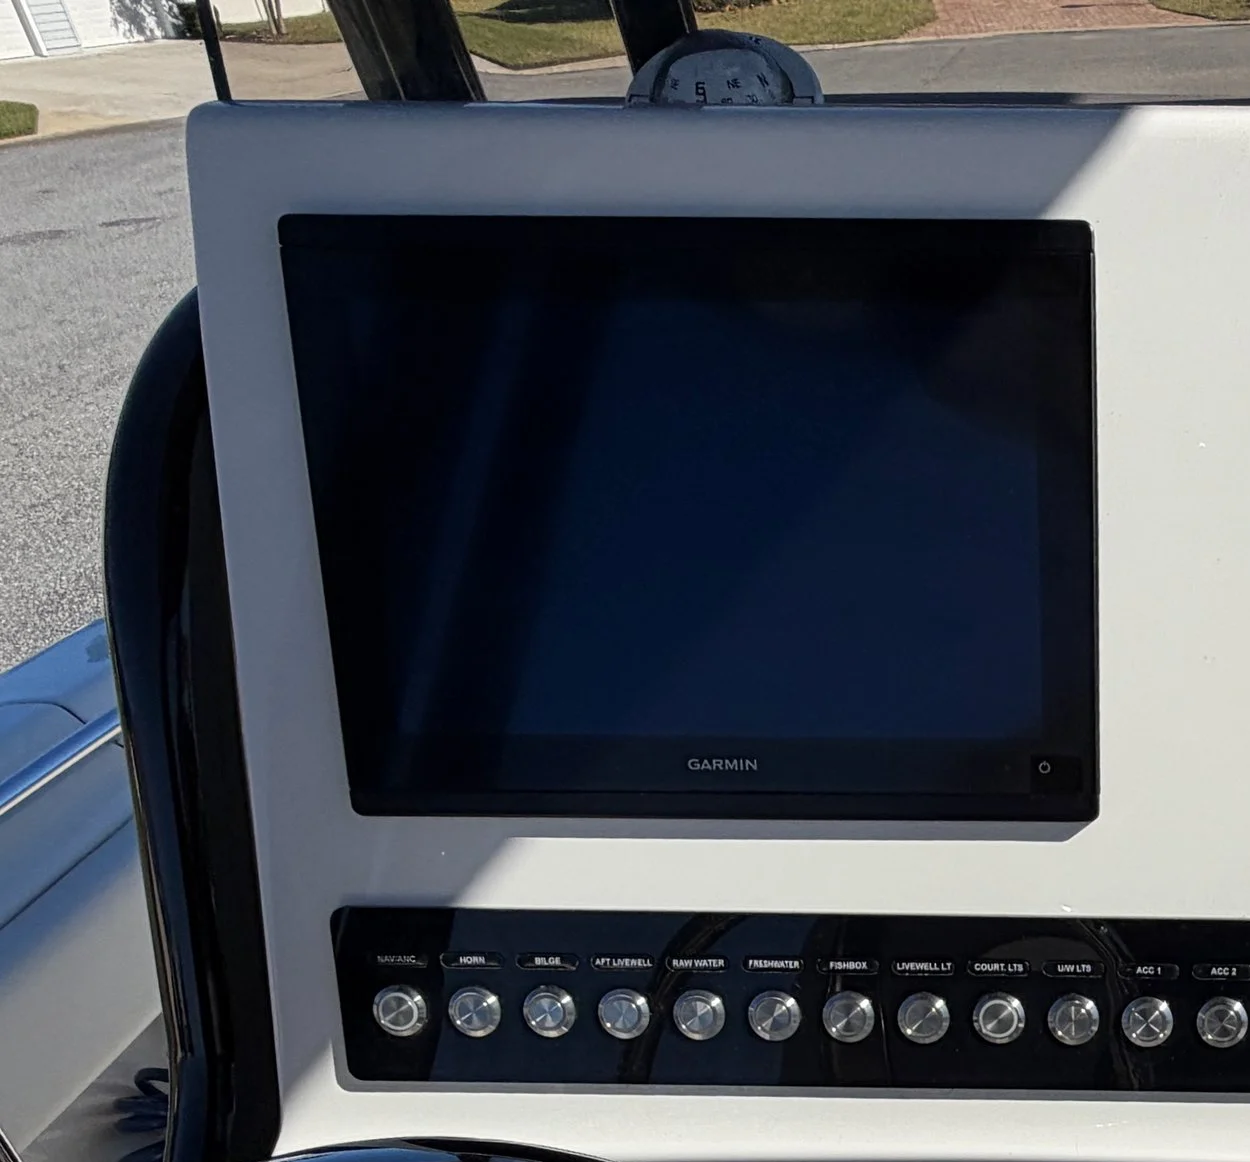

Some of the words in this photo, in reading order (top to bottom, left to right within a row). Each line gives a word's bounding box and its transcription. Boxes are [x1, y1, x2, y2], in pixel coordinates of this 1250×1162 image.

[727, 78, 741, 90] NE
[687, 758, 758, 771] GARMIN
[460, 956, 486, 964] HORN
[534, 957, 561, 965] BILGE
[595, 958, 612, 966] AFT
[612, 958, 653, 967] LIVEWELL
[672, 958, 691, 968] RAW
[693, 959, 725, 968] WATER
[748, 960, 800, 969] FRESHWATER
[829, 961, 868, 970] FISHBOX
[897, 962, 940, 971] LIVEWELL
[941, 962, 952, 971] LT
[974, 963, 1006, 973] COURT.
[1007, 963, 1024, 972] LTS
[1076, 964, 1092, 973] LTS
[1136, 966, 1154, 975] ACC
[1156, 966, 1162, 975] 1
[1211, 967, 1228, 977] ACC
[1230, 968, 1237, 977] 2
